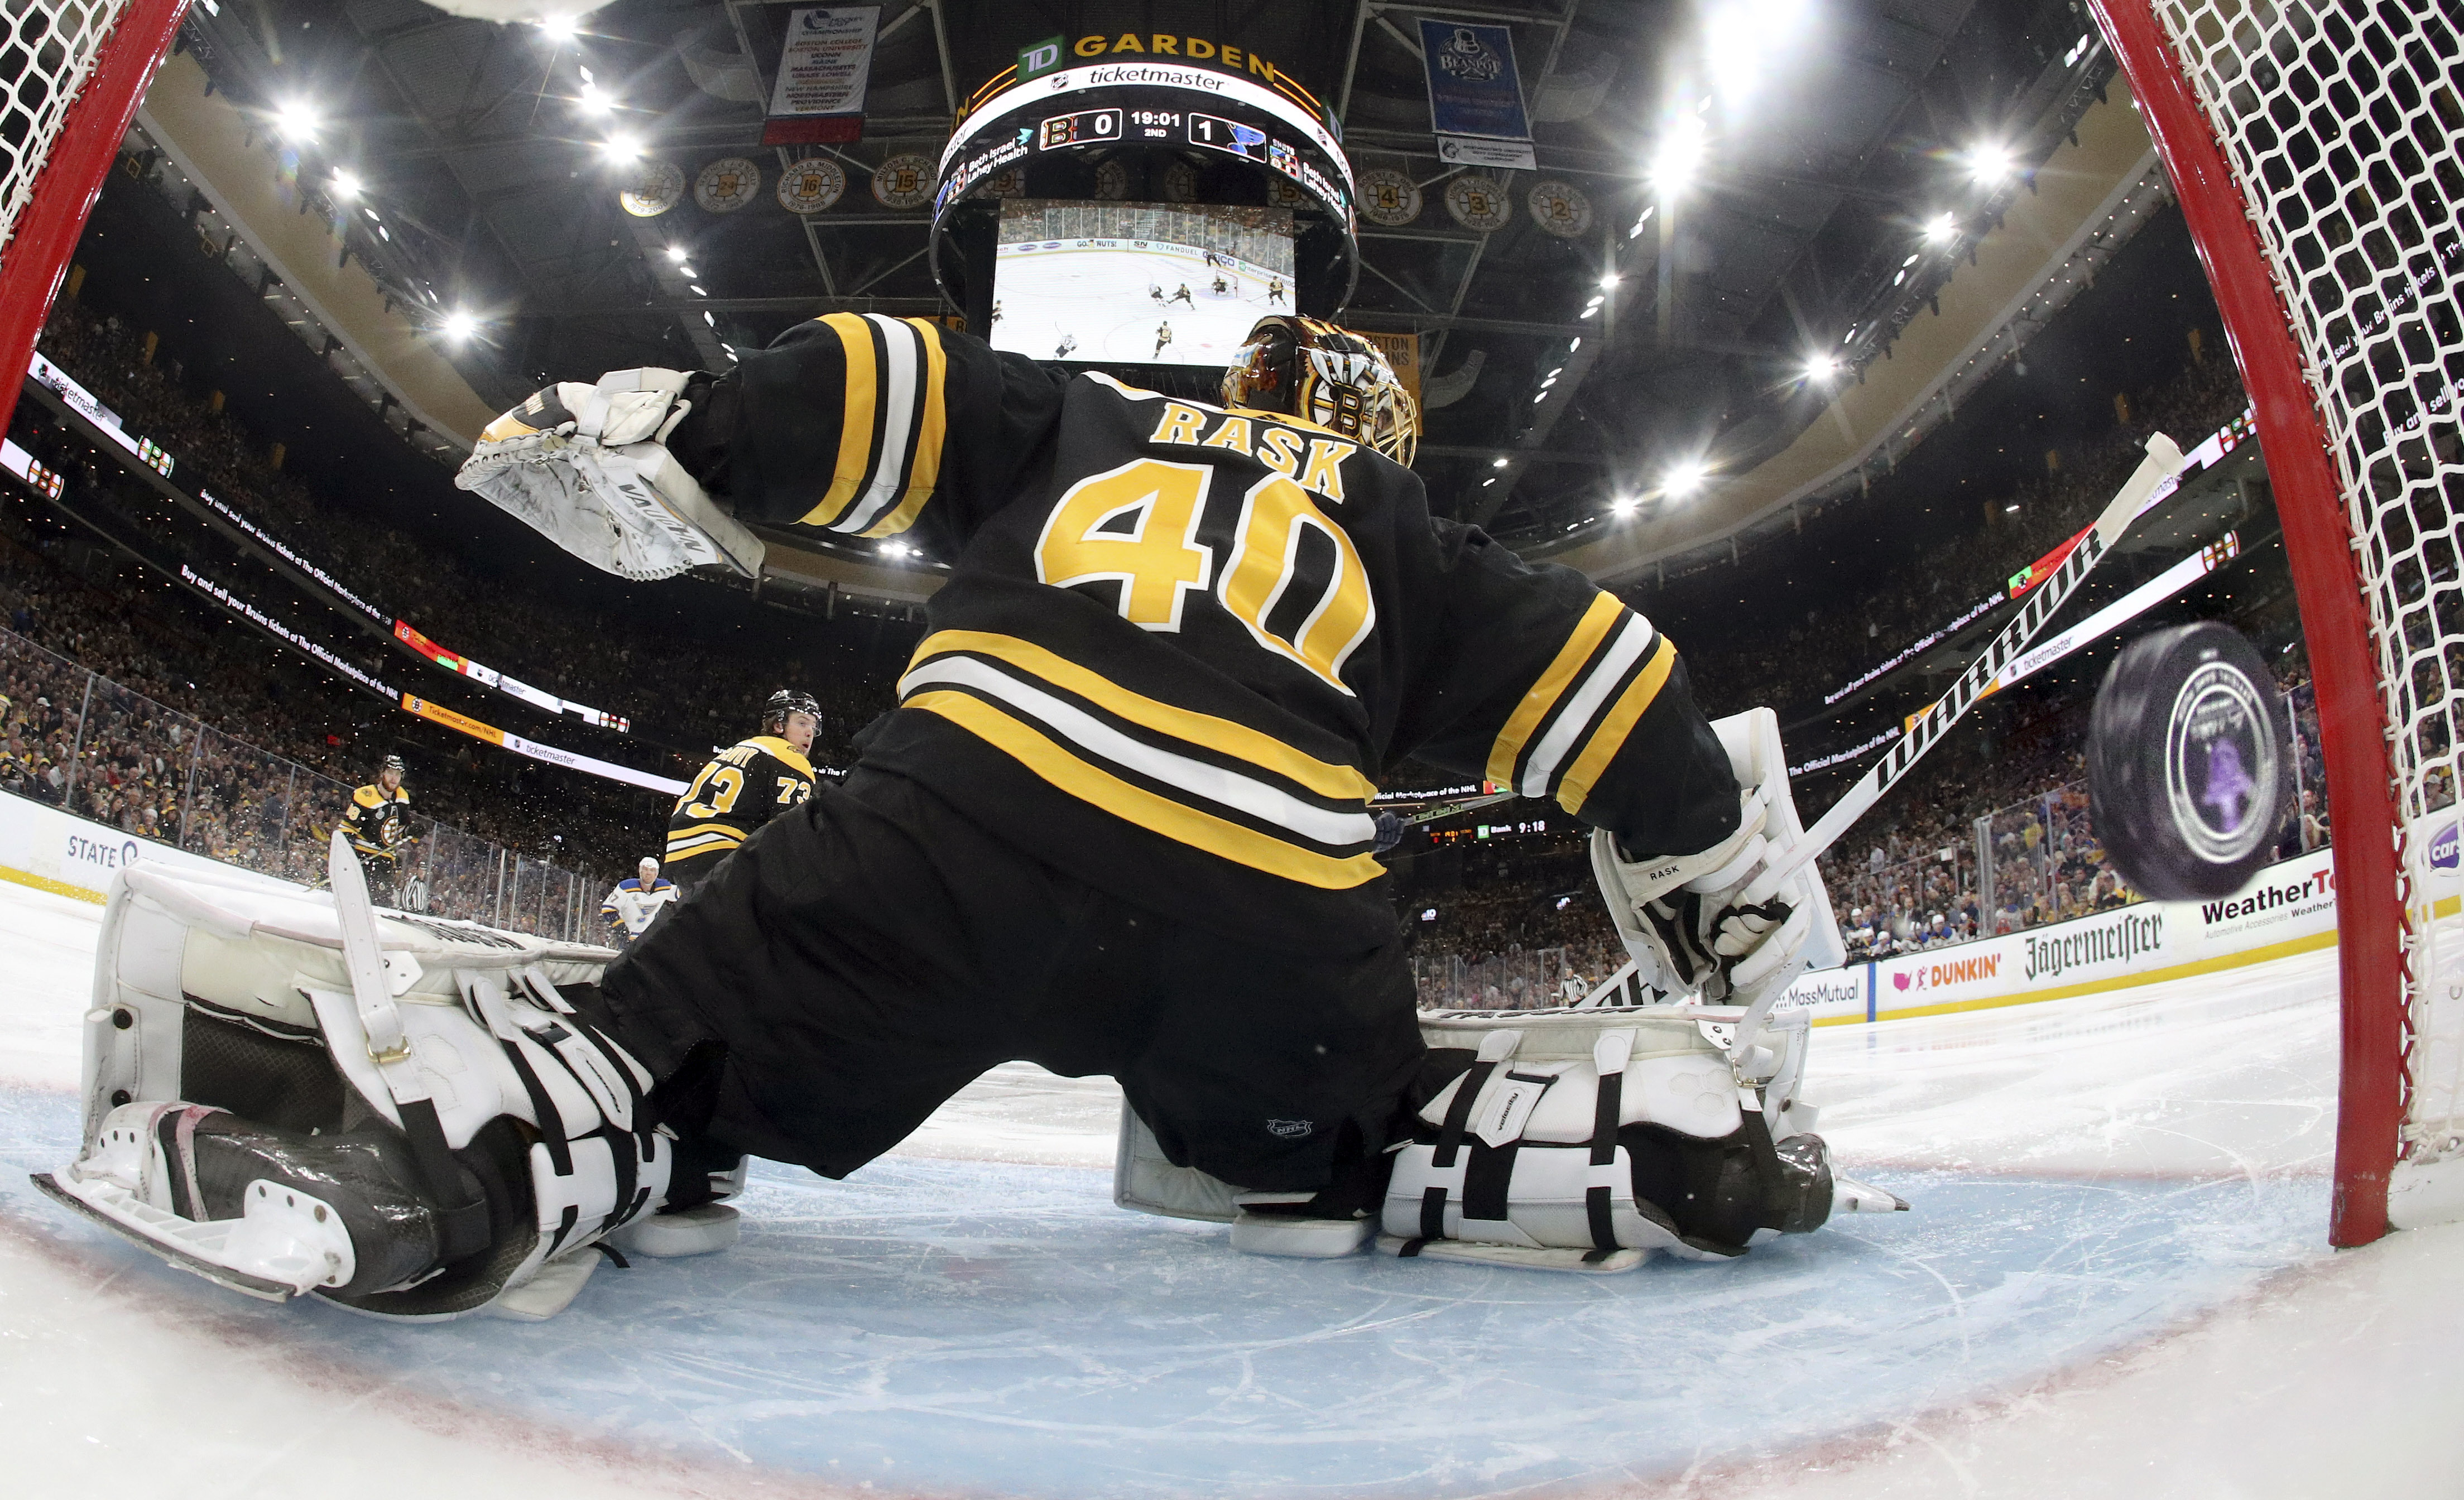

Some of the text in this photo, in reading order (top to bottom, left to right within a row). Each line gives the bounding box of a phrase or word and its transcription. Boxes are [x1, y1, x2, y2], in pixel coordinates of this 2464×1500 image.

[1022, 33, 1274, 83] TD GARDEN
[1090, 66, 1224, 90] ticketmaster
[1095, 115, 1112, 134] 0
[1131, 112, 1180, 127] 19:01
[1145, 129, 1166, 137] 2ND
[1198, 121, 1211, 141] 1
[968, 162, 993, 184] Lahey
[994, 146, 1028, 167] Health
[969, 153, 988, 172] Beth
[990, 137, 1016, 159] Israel
[804, 179, 818, 191] 16
[817, 161, 840, 193] MIDDLETON
[898, 175, 914, 188] 15
[1303, 162, 1323, 185] Beth
[1304, 174, 1327, 201] Lahey
[1382, 190, 1394, 203] 4
[1554, 202, 1567, 216] 2
[1166, 245, 1198, 256] FANDUEL
[2430, 385, 2450, 412] sell
[1149, 402, 1356, 504] RASK
[618, 483, 706, 554] VAUGHN
[302, 560, 314, 574] The
[313, 568, 334, 588] Official
[1033, 458, 1376, 698] 40
[181, 564, 398, 700] Buy and sell your Bruins tickets at The Official Marketplace of the NHL
[1914, 633, 1937, 652] Official
[1989, 591, 2006, 607] NHL
[2024, 635, 2073, 670] ticketmaster
[429, 706, 497, 738] Ticketmaster.com/NHL
[526, 744, 575, 765] ticketmaster
[1788, 726, 1900, 777] The Official Marketplace of the NHL
[672, 761, 744, 819] 73
[777, 776, 811, 804] 73
[1439, 787, 1448, 796] of
[1448, 786, 1460, 795] the
[1461, 784, 1477, 794] NHL
[1491, 825, 1512, 833] Bank
[1519, 820, 1545, 834] 9:18
[68, 835, 117, 868] STATE
[1650, 864, 1680, 881] RASK
[2205, 922, 2242, 939] Automotive
[2244, 912, 2289, 930] Accessories
[1930, 953, 2001, 987] DUNKIN'
[1789, 978, 1858, 1007] MassMutual
[1498, 1092, 1518, 1131] velocity
[1277, 1123, 1310, 1135] NHL
